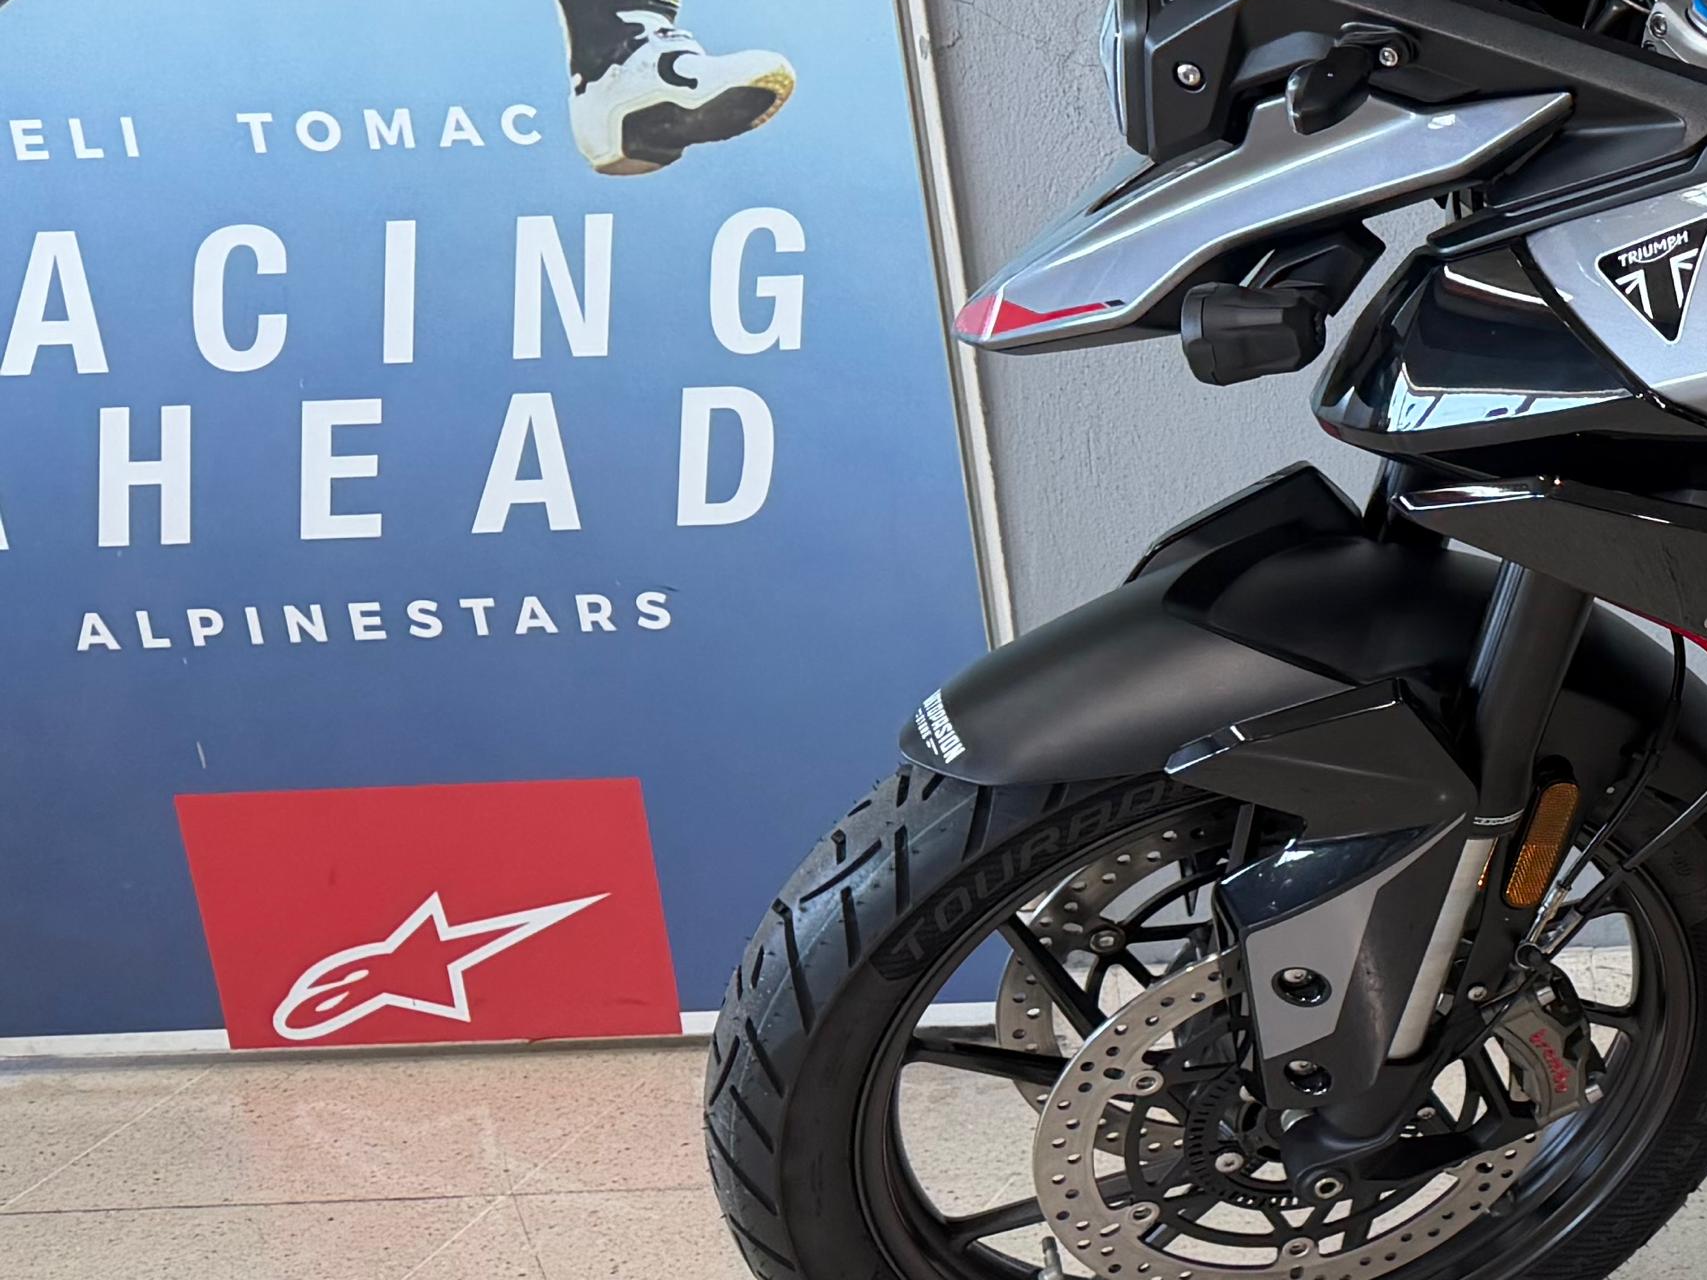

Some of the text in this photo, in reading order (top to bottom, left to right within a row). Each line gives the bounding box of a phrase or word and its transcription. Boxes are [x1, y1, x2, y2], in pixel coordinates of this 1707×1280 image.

[9, 104, 542, 161] ELI TOMAC
[1617, 230, 1690, 268] TRIUMPH
[0, 386, 775, 551] HEAD
[76, 591, 672, 651] ALPINESTARS
[1529, 1027, 1577, 1095] brembo
